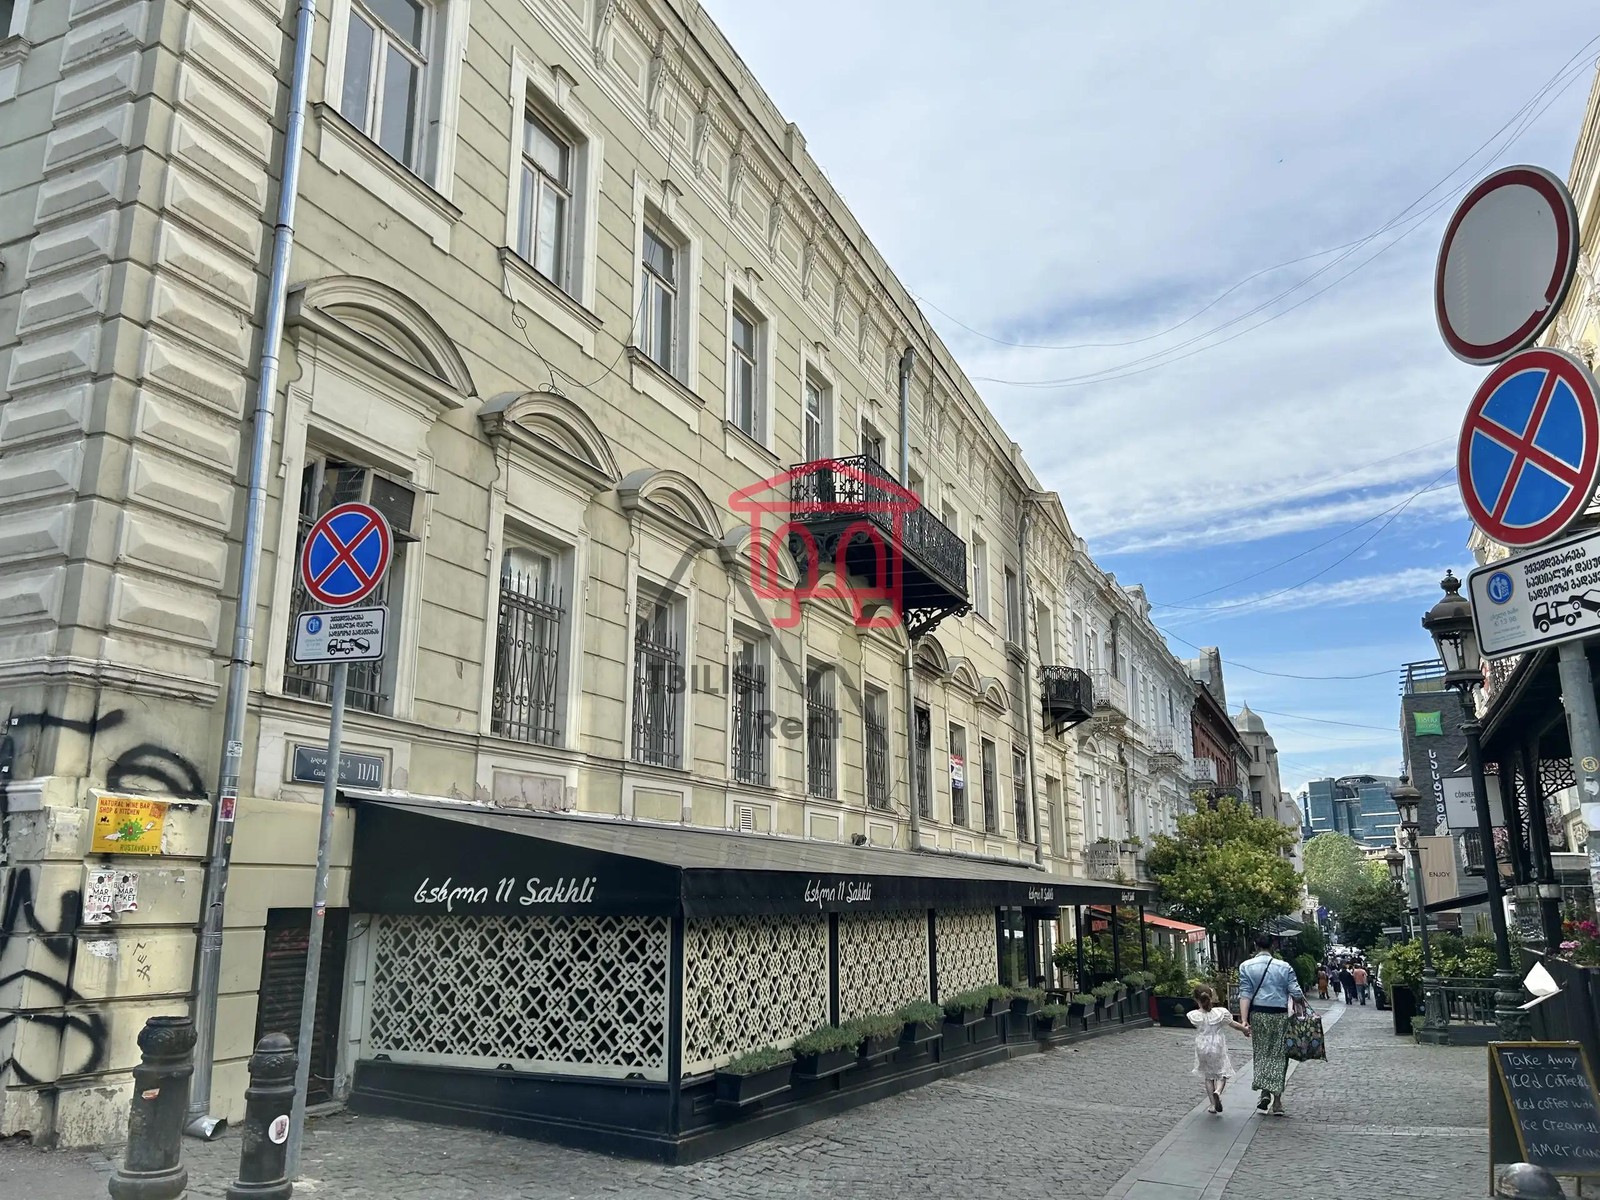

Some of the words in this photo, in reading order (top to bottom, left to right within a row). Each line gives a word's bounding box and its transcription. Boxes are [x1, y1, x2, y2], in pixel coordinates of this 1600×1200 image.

[100, 799, 123, 808] NATURAL
[125, 800, 140, 809] WINE
[99, 806, 112, 814] SHOP
[119, 808, 140, 816] KITCHEN
[119, 844, 150, 853] RUSTAVELI
[93, 888, 109, 896] MAR
[118, 887, 134, 895] MAR
[519, 876, 597, 906] Sakhli
[846, 881, 872, 904] Sakhli
[1502, 1052, 1542, 1066] Take
[1548, 1054, 1578, 1068] Away
